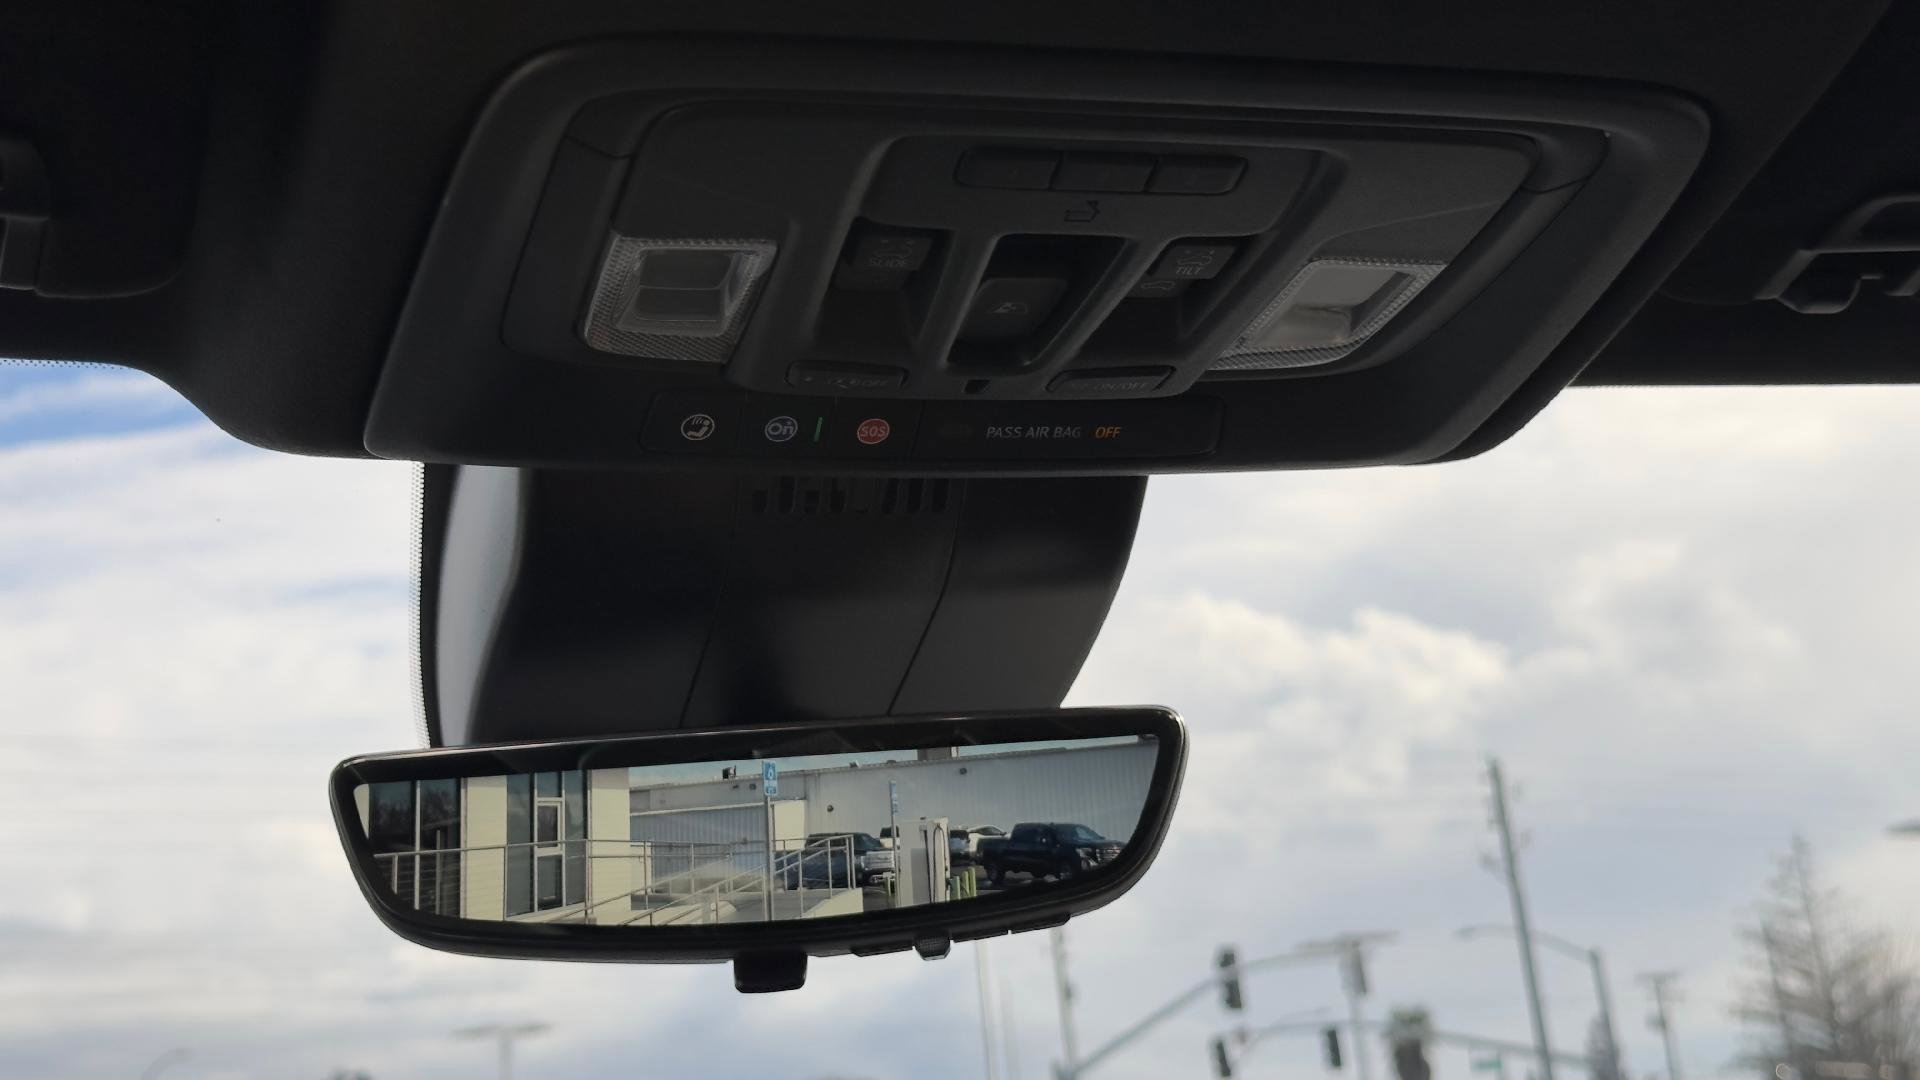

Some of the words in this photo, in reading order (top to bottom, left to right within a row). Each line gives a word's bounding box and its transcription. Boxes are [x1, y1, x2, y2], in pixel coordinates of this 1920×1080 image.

[1176, 265, 1206, 276] TILT
[859, 425, 887, 438] SOS
[985, 425, 1023, 440] PASS
[1024, 425, 1051, 440] AIR
[1053, 425, 1082, 440] BAG
[1095, 425, 1121, 440] OFF
